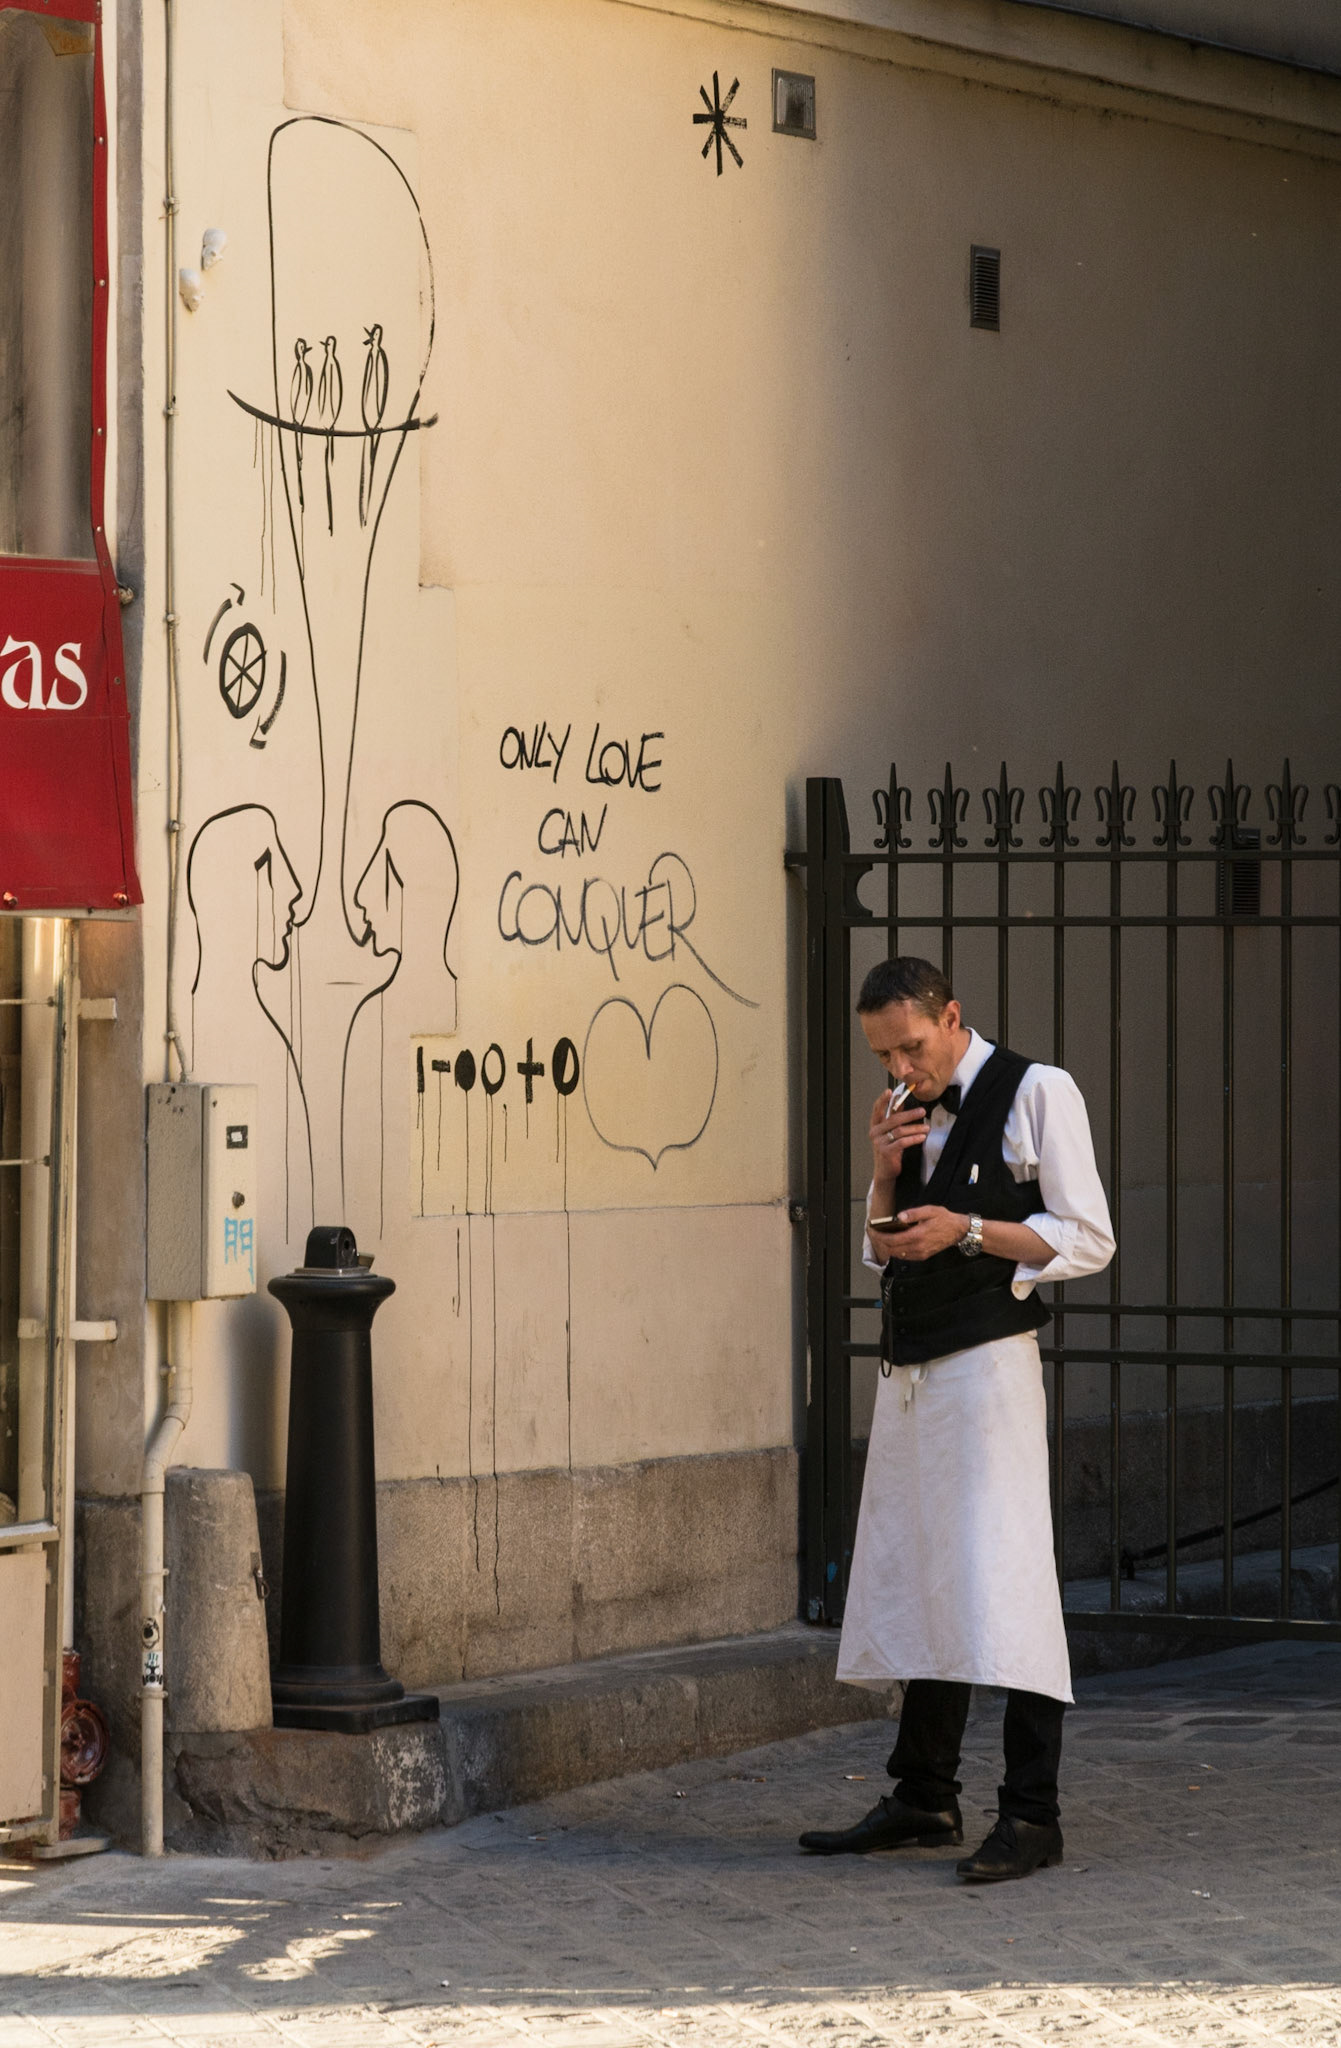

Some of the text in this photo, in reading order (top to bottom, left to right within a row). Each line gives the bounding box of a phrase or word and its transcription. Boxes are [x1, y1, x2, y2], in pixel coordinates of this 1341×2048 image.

[499, 721, 665, 793] ONLY LOVE
[538, 803, 608, 858] CAN
[498, 852, 760, 1008] CONQUER
